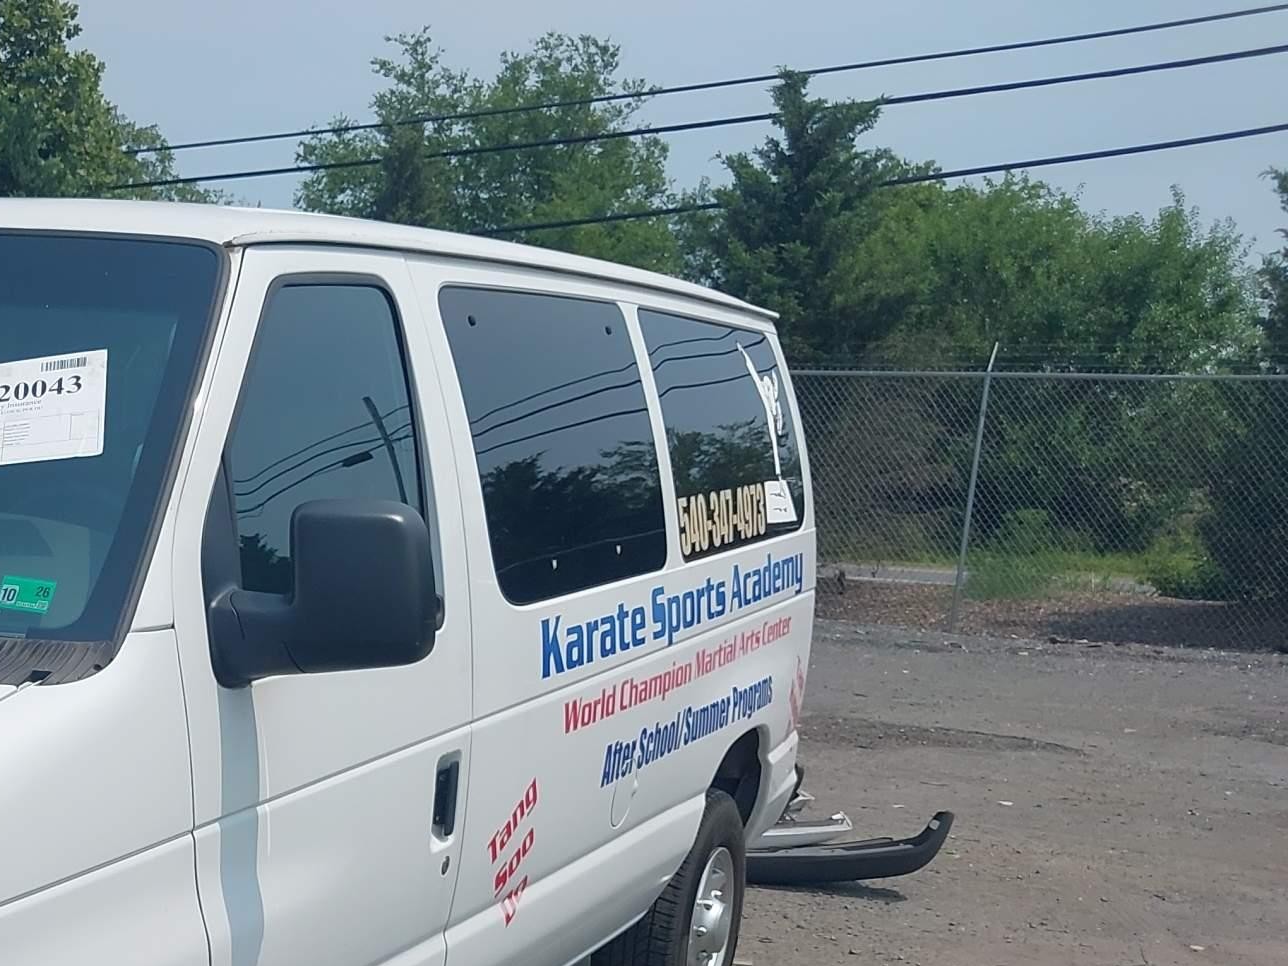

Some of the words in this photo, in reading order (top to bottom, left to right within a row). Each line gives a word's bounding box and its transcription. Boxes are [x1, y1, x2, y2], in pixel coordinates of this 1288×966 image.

[677, 482, 766, 556] 540-347-4973
[1, 588, 17, 602] 10
[541, 604, 646, 680] Karate
[651, 577, 726, 647] Sports
[730, 551, 804, 613] Academy
[564, 680, 615, 735] World
[620, 659, 693, 709] Champion
[695, 639, 738, 680] Martial
[739, 630, 761, 660] Arts
[762, 614, 792, 646] Center
[600, 738, 638, 788] After
[637, 702, 730, 769] School/Summer
[732, 674, 773, 724] Programs
[487, 777, 538, 864] Tang
[494, 828, 535, 899] Soo
[499, 875, 529, 928] Do
